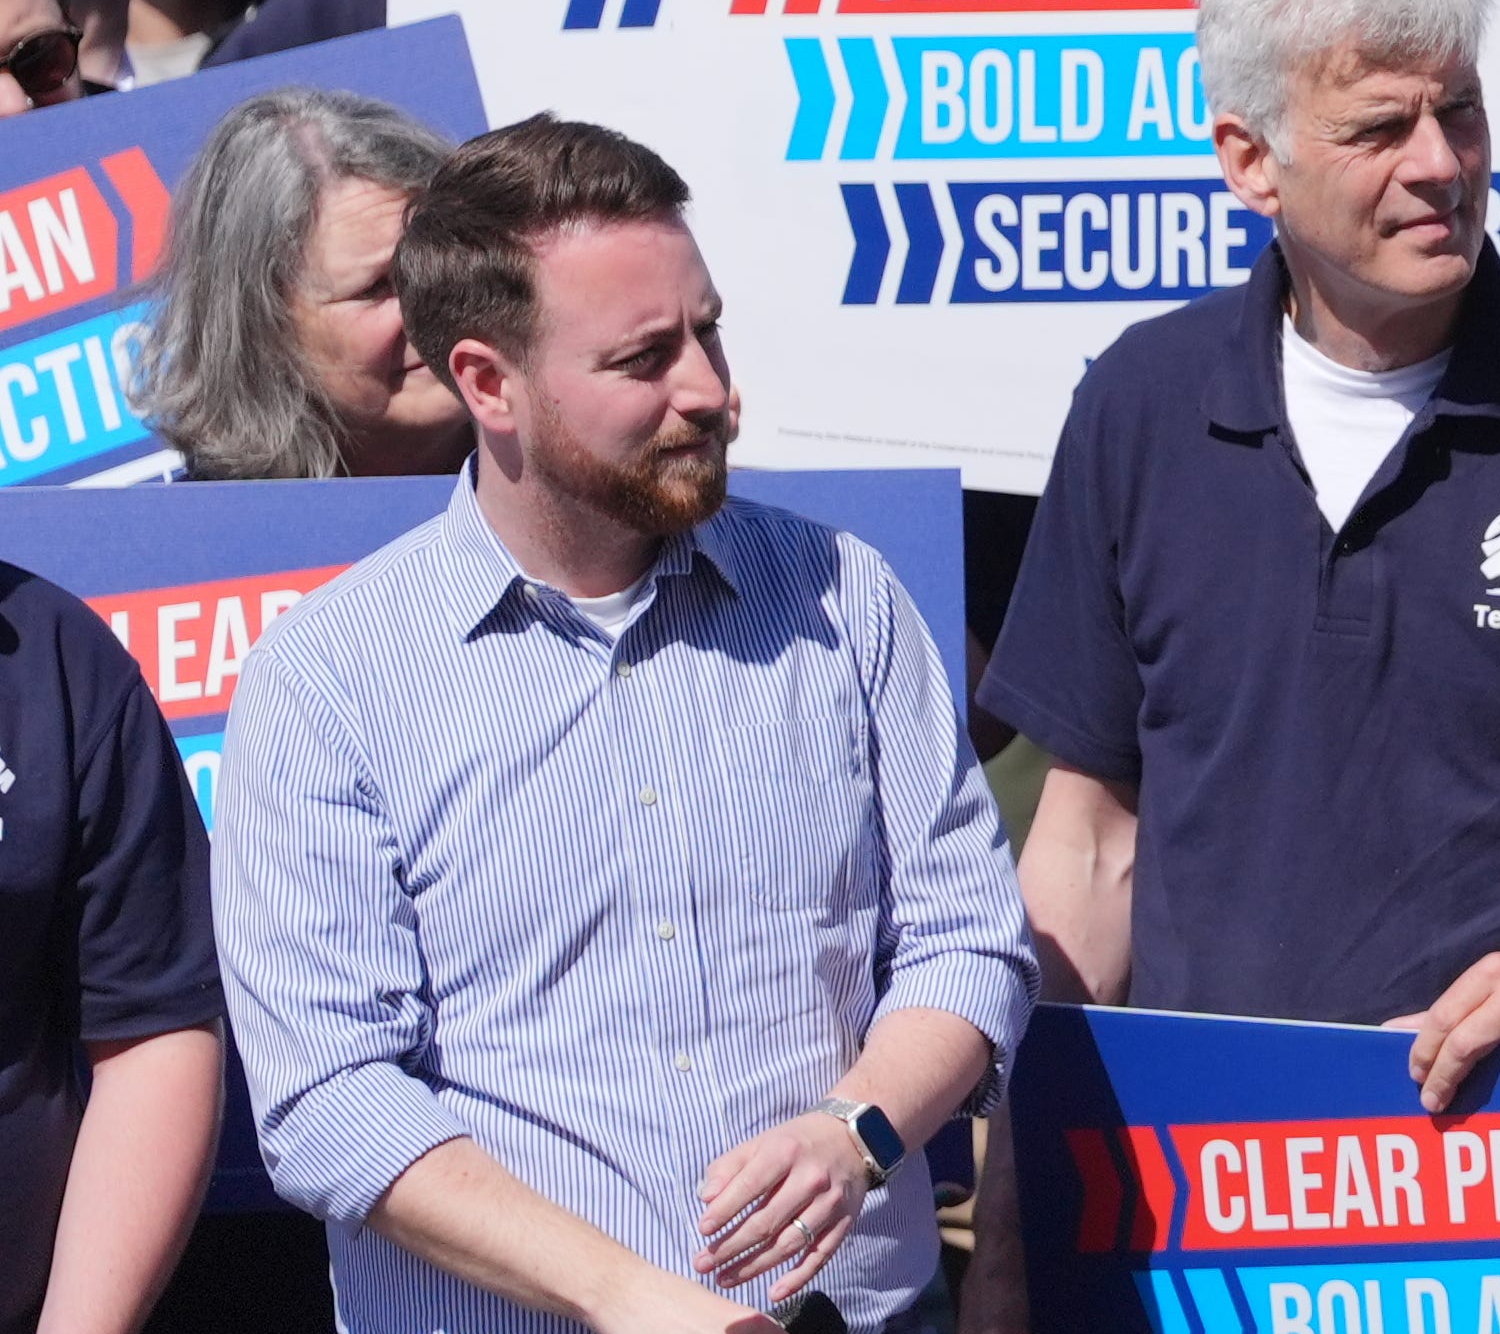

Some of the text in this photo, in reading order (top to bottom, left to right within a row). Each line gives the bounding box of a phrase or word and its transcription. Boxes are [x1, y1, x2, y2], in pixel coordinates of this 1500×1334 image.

[921, 48, 1104, 145] BOLD
[0, 187, 94, 312] AN
[974, 191, 1252, 292] SECURE
[0, 320, 155, 466] CTIO
[1201, 1133, 1423, 1234] CLEAR
